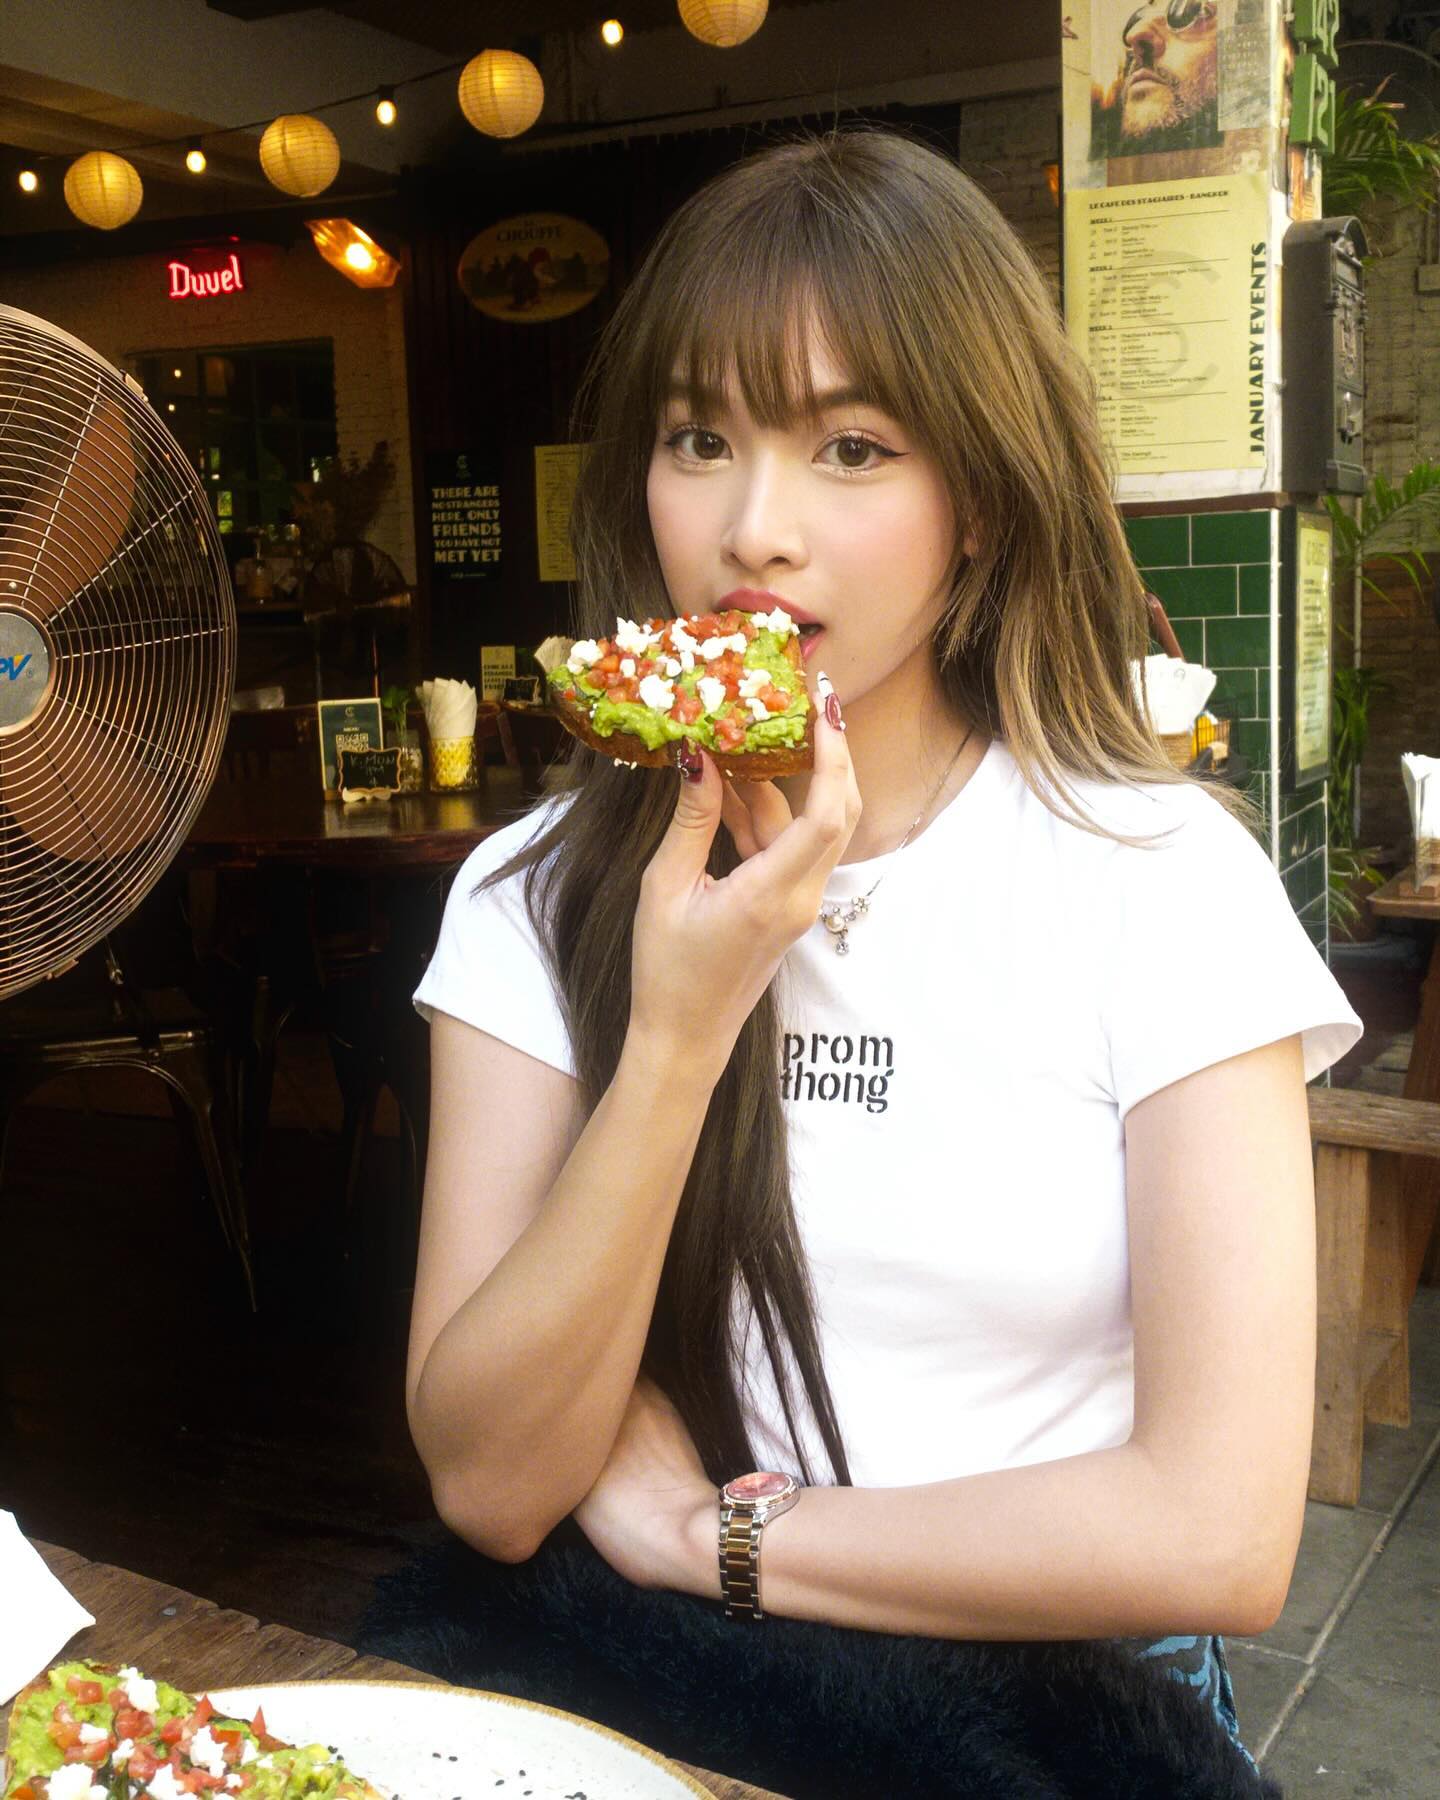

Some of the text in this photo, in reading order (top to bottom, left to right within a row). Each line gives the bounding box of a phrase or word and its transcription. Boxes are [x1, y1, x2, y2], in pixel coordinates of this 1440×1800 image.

[168, 253, 243, 298] Duvel
[1248, 241, 1266, 456] JANUARY EVENTS
[432, 485, 500, 499] THERE ARE
[467, 509, 500, 520] ONLY
[432, 522, 502, 536] FRIENDS
[434, 549, 502, 562] MET YET
[783, 1033, 894, 1069] prom
[780, 1061, 895, 1114] thong
